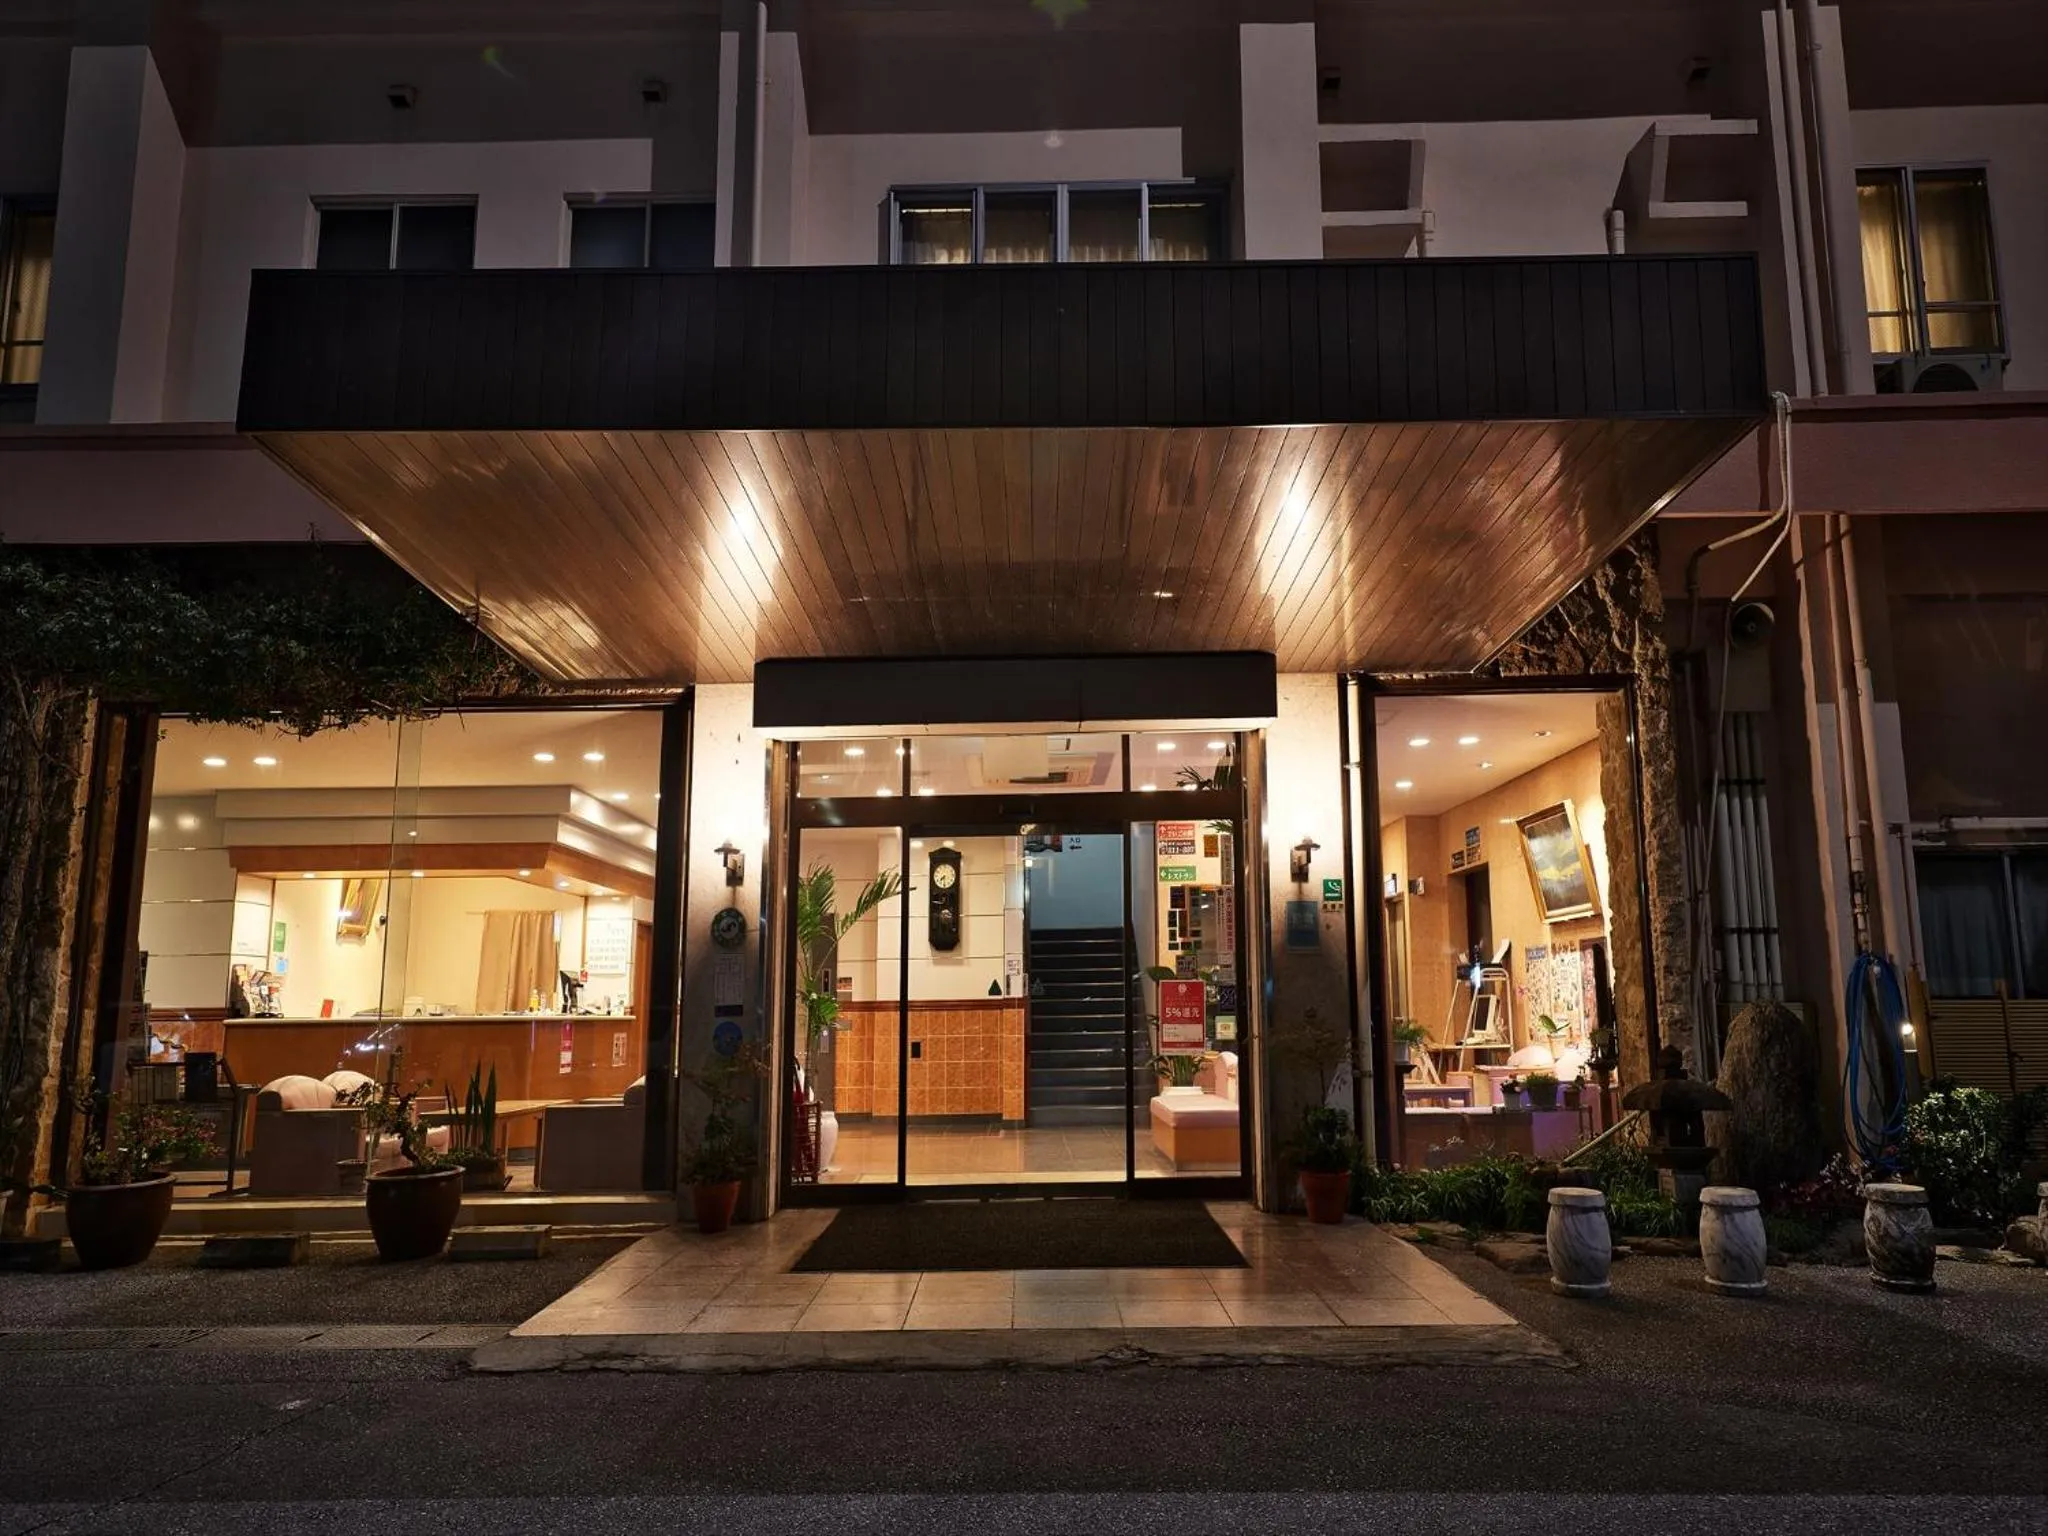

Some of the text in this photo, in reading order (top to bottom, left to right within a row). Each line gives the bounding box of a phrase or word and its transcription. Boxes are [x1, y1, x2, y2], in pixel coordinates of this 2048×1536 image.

[1168, 872, 1193, 880] レストラン
[1165, 1007, 1200, 1018] 5%還元
